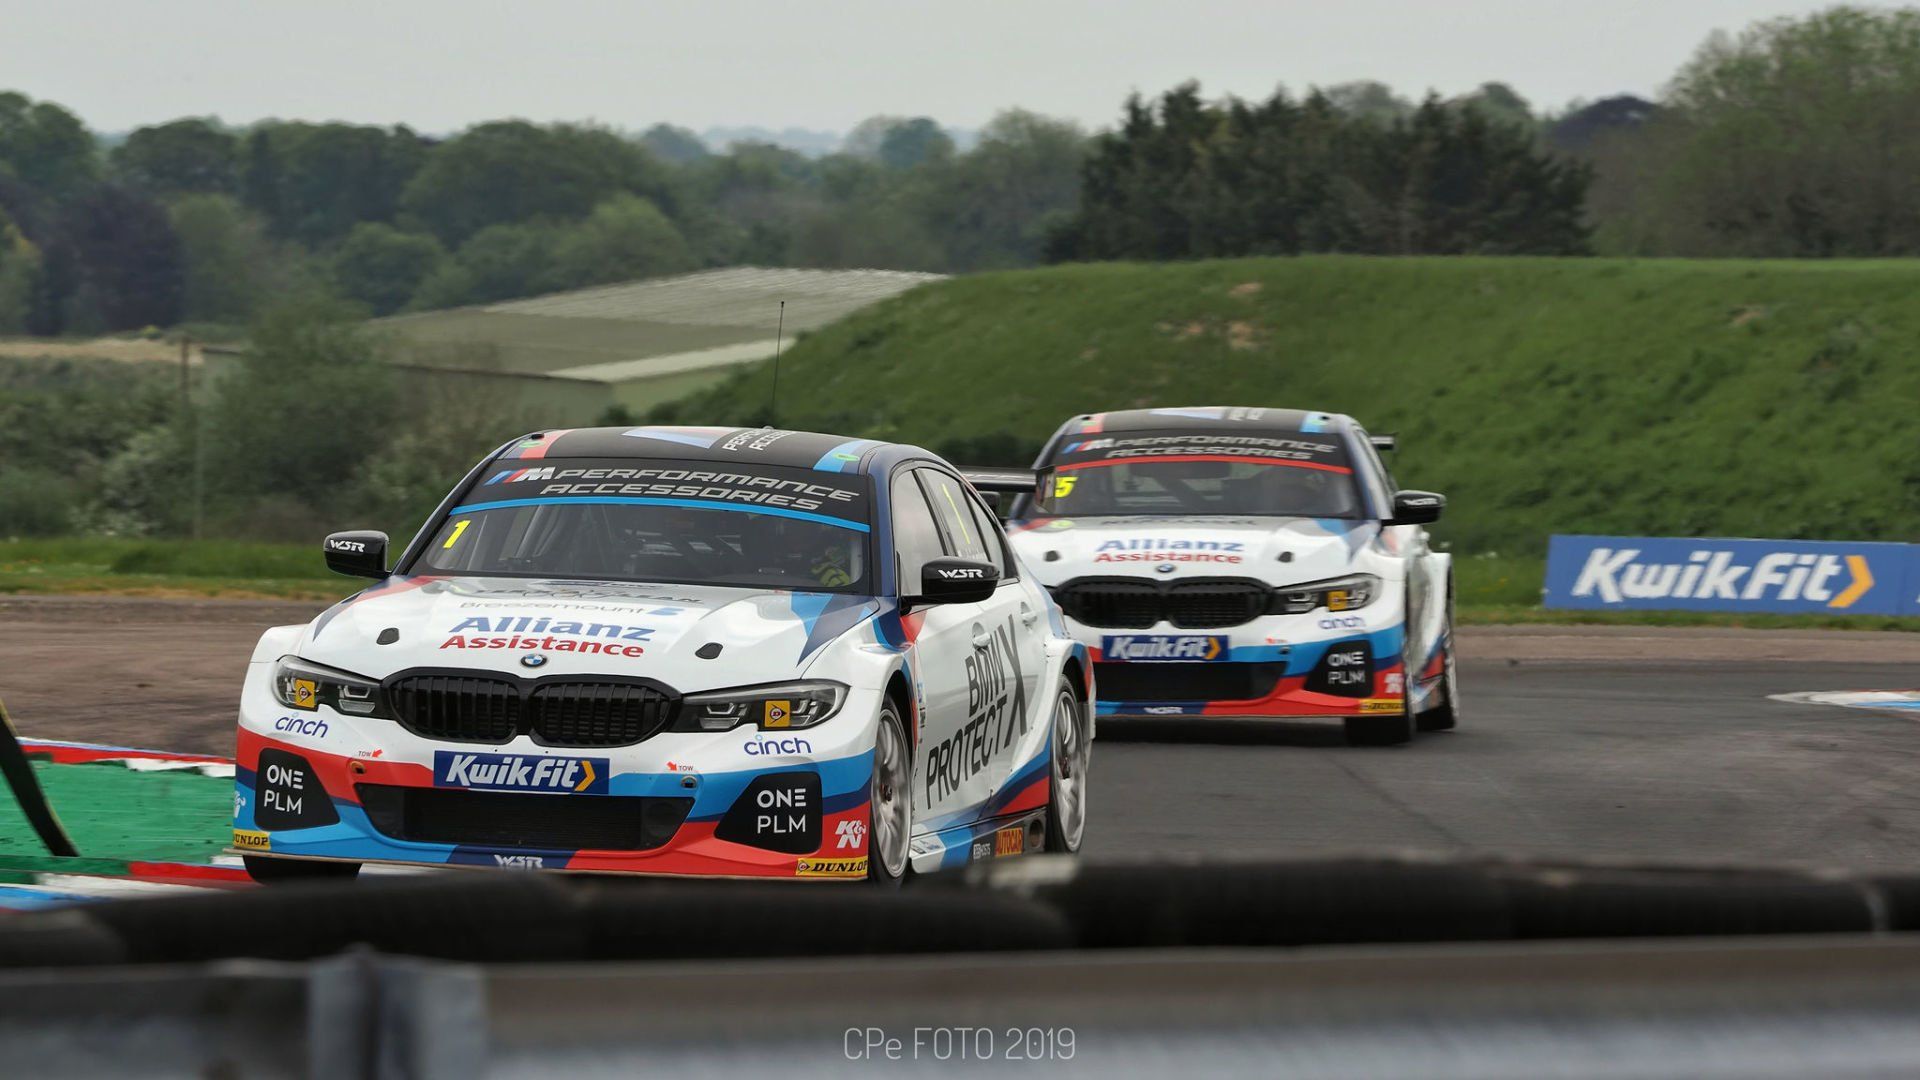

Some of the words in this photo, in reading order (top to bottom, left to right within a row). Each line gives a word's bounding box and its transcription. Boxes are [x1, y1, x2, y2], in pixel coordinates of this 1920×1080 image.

[1105, 447, 1313, 460] ACCESSORIES
[1111, 436, 1338, 451] PERFORMANCE
[555, 469, 860, 501] PERFORMANCE
[540, 484, 823, 511] ACCESSORIES
[442, 519, 471, 549] 1
[330, 539, 366, 552] WSR
[1096, 539, 1245, 552] Allianz
[1093, 552, 1243, 564] Assistance
[938, 569, 984, 578] WSR
[1571, 549, 1842, 603] KwikFit
[448, 616, 656, 642] Allianz
[439, 634, 644, 658] Assistance
[1327, 651, 1366, 667] ONE
[964, 631, 1006, 718] BMW
[1328, 671, 1366, 684] PLM
[274, 713, 329, 738] cinch
[743, 735, 812, 756] cinch
[926, 693, 1008, 810] PROTECT
[266, 764, 304, 790] ONE
[446, 754, 580, 789] KwikFit
[263, 789, 303, 815] PLM
[756, 788, 807, 808] ONE
[757, 815, 806, 834] PLM
[234, 834, 269, 846] UNLOP
[493, 854, 543, 869] WSR
[811, 860, 868, 872] DUNLOP
